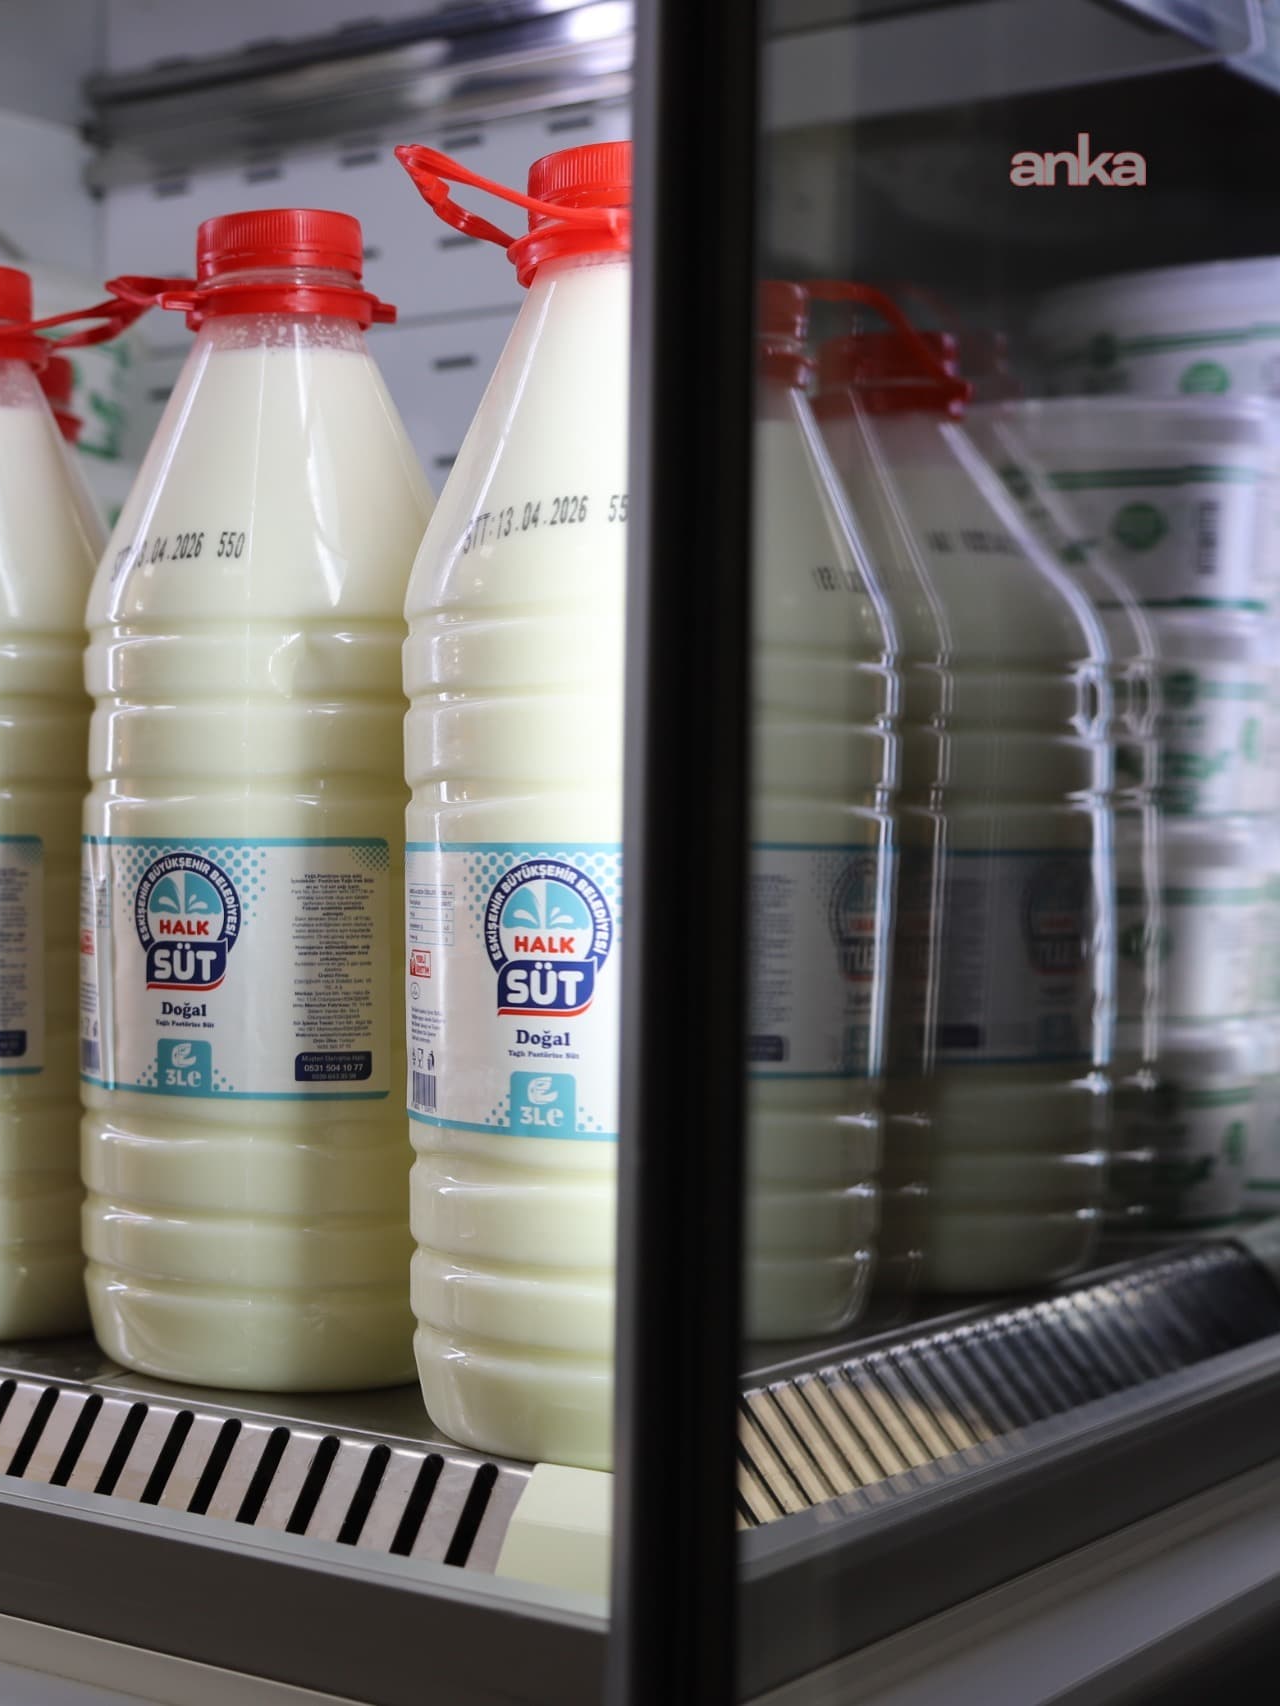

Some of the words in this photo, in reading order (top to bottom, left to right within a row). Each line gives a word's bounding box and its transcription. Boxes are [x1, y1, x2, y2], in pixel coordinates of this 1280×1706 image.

[217, 531, 246, 559] 550
[136, 883, 152, 942] ESKİŞEHİR
[148, 857, 211, 883] BÜYÜKŞEHİR
[209, 870, 238, 937] BELEDİYESİ
[486, 892, 505, 960] ESKİŞEHİR
[502, 864, 577, 894] BÜYÜKŞEHİR
[574, 879, 611, 955] BELEDİYESİ
[159, 919, 209, 936] HALK
[514, 936, 575, 953] HALK
[154, 943, 217, 982] SÜT
[506, 962, 584, 1006] SÜT
[161, 1001, 207, 1019] Doğal
[516, 1029, 571, 1048] Doğal
